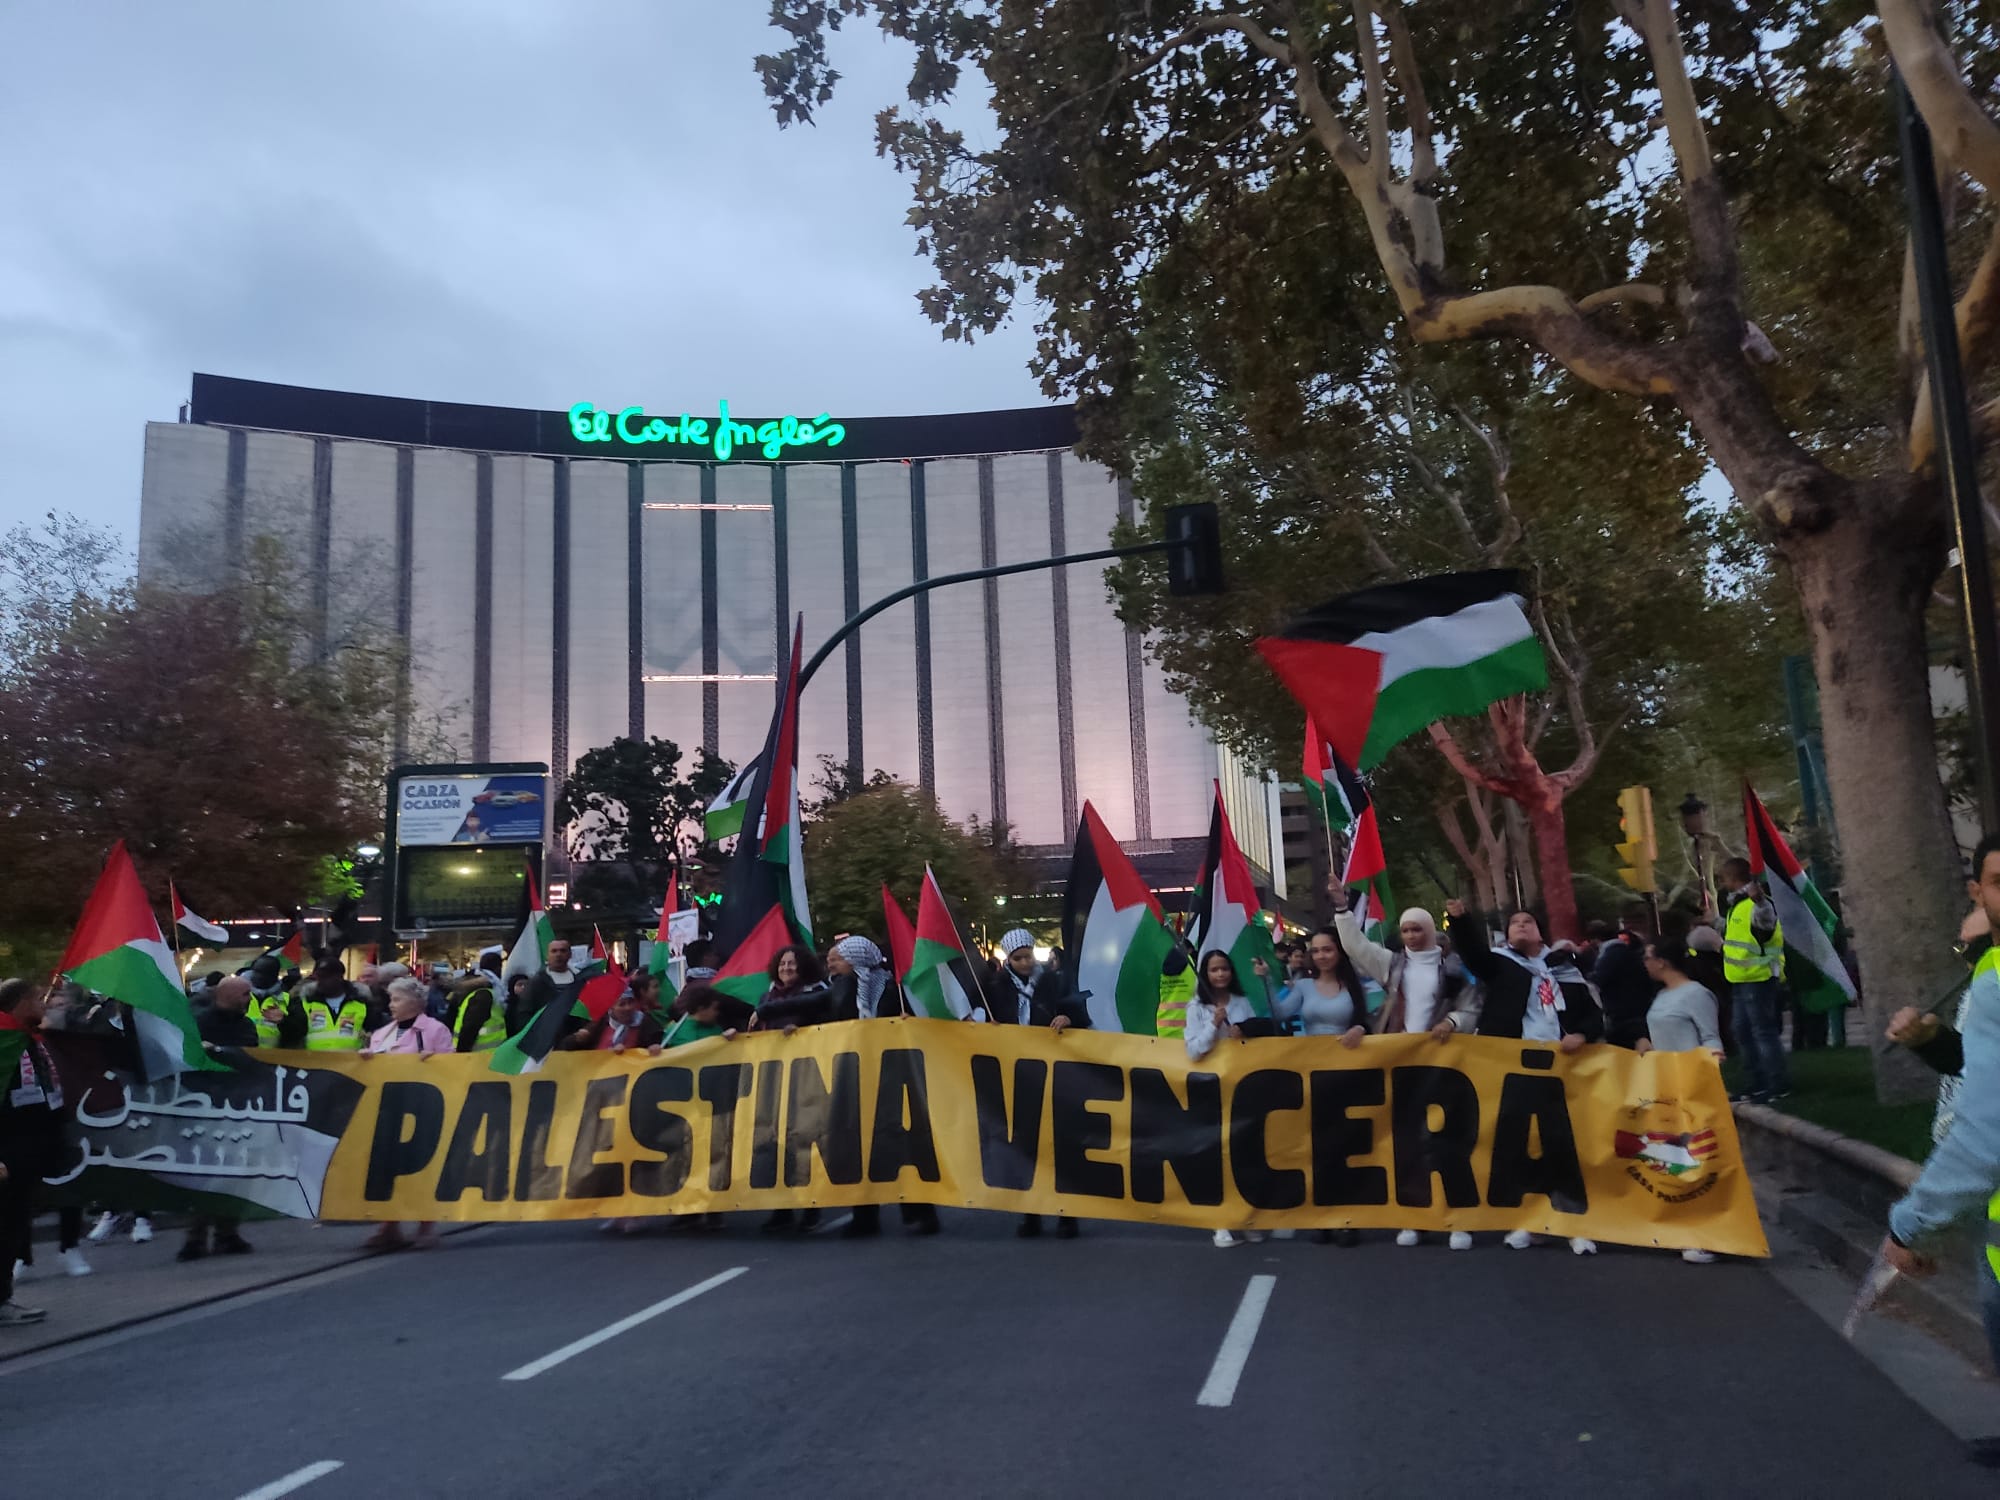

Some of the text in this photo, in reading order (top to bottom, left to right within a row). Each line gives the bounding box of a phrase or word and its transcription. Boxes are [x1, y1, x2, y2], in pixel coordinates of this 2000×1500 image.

[569, 399, 847, 461] El Corte Inglés
[405, 785, 459, 798] CARZA
[76, 1065, 310, 1130] فلسطين
[363, 1048, 1589, 1214] PALESTINA VENCERÁ
